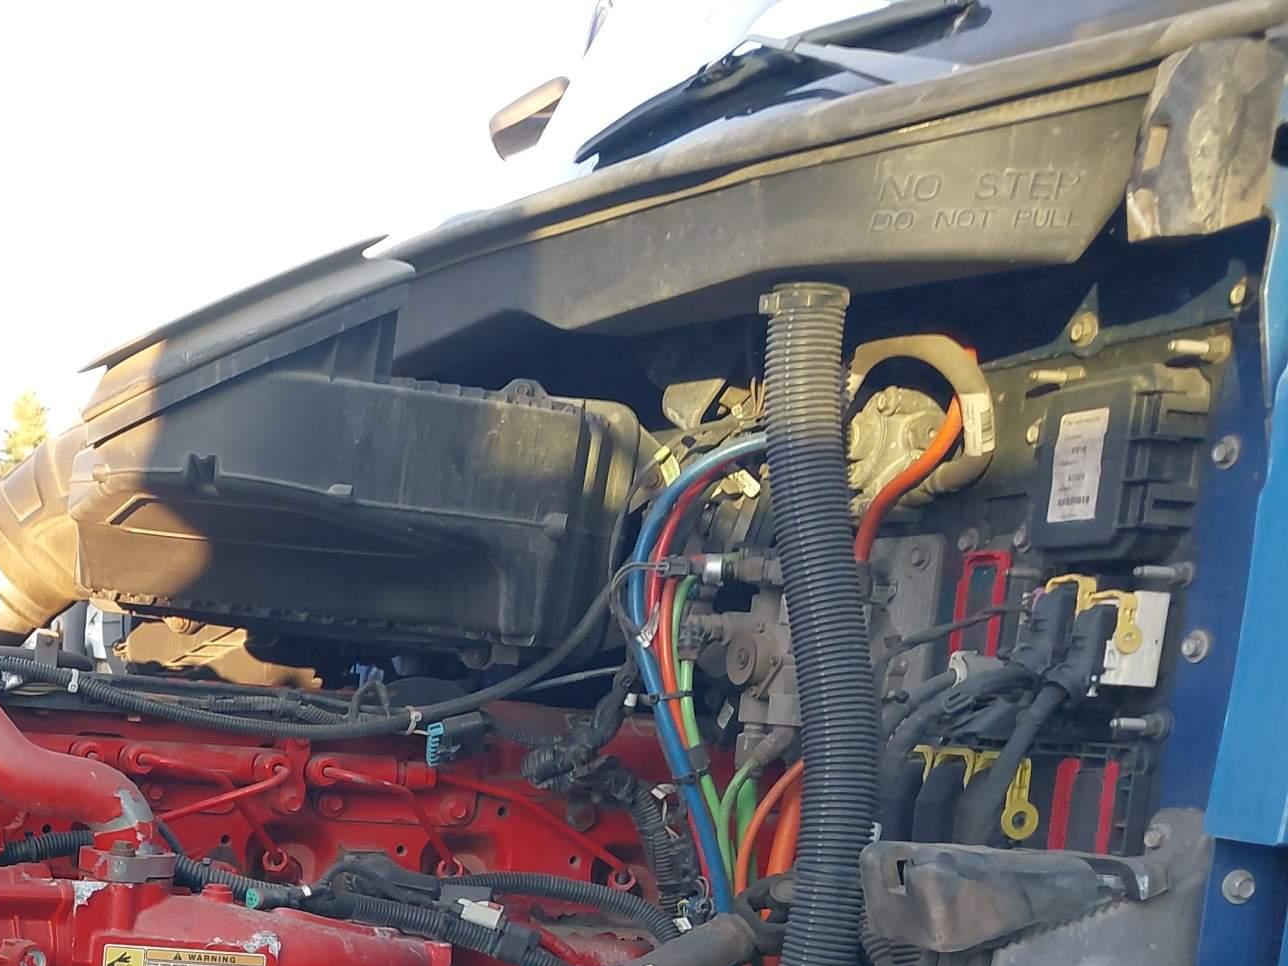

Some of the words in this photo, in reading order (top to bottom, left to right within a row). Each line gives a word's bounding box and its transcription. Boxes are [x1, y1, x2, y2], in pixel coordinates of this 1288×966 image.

[879, 172, 944, 203] NO
[975, 168, 1082, 201] STEP
[870, 209, 916, 233] DO
[935, 208, 997, 230] NOT
[1013, 207, 1080, 229] PULL
[188, 953, 237, 964] WARNING
